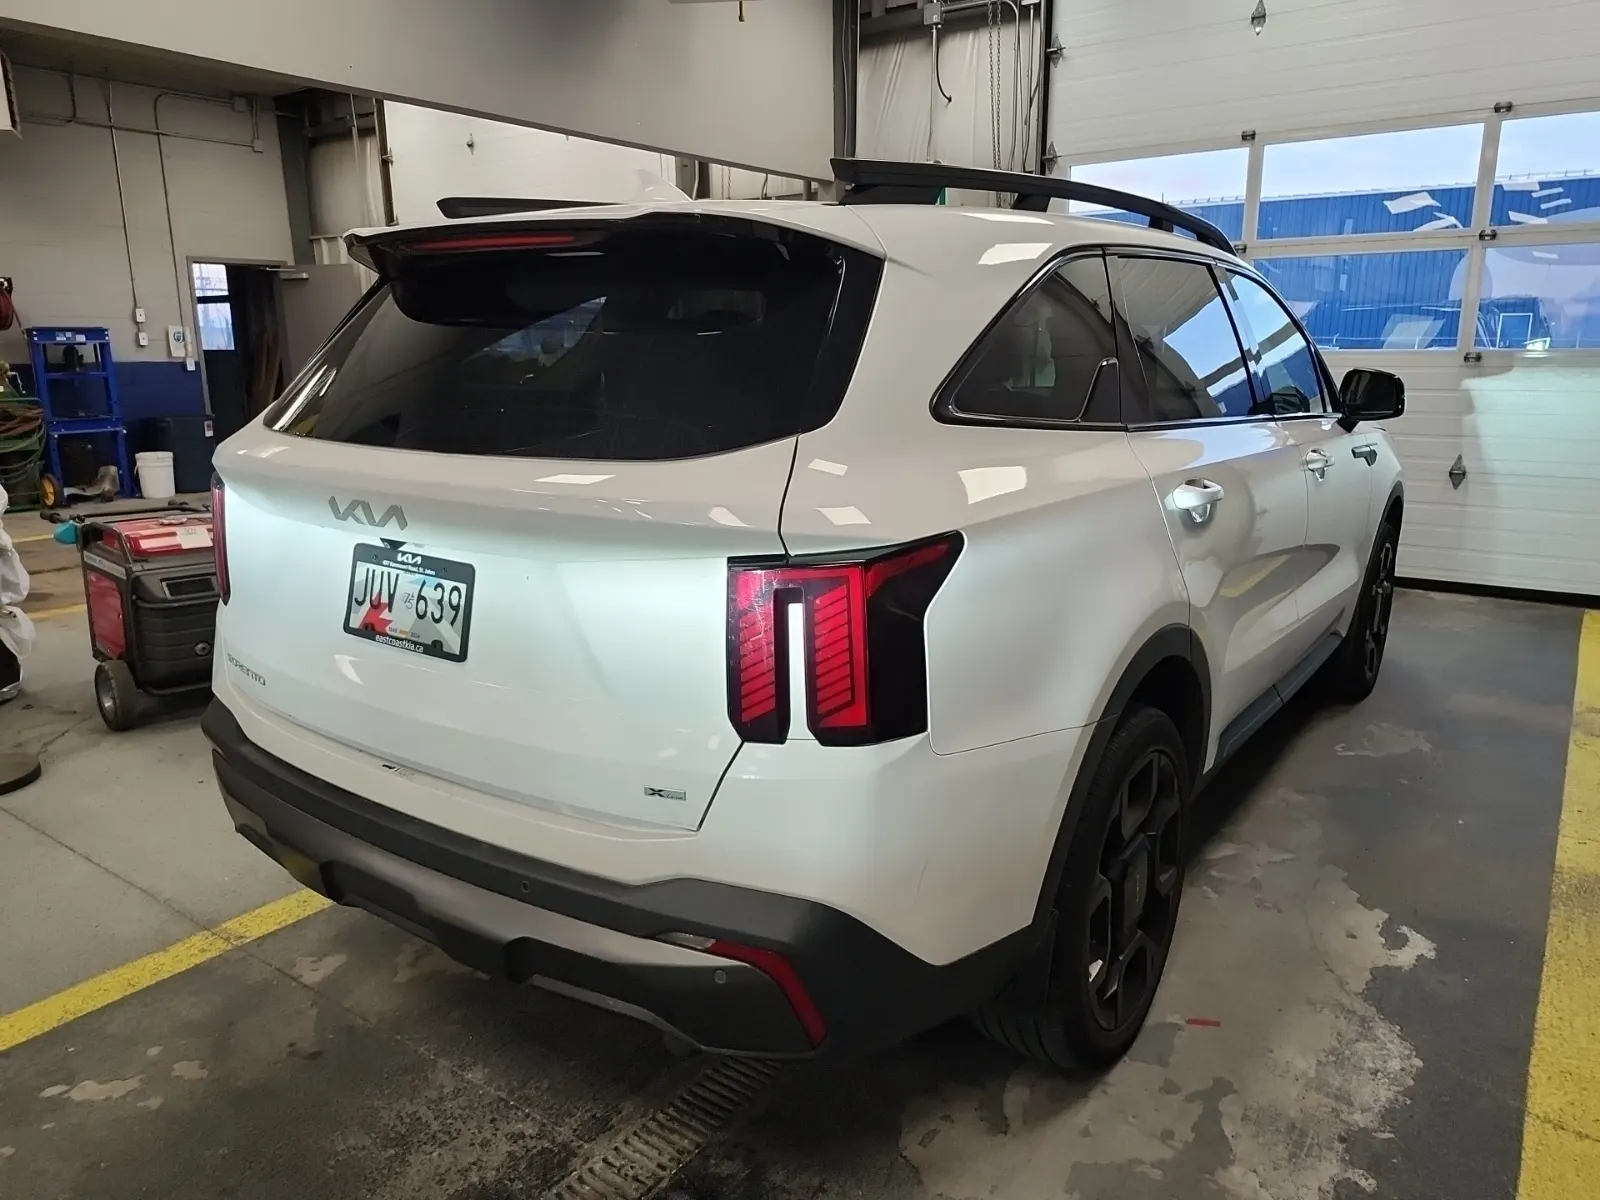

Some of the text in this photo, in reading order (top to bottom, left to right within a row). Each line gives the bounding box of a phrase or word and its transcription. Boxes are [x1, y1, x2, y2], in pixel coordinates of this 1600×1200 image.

[328, 495, 408, 531] KIA
[397, 552, 422, 565] KIA
[354, 568, 400, 613] JUV
[415, 580, 462, 627] 639
[375, 634, 424, 653] eastcoastkia.ca
